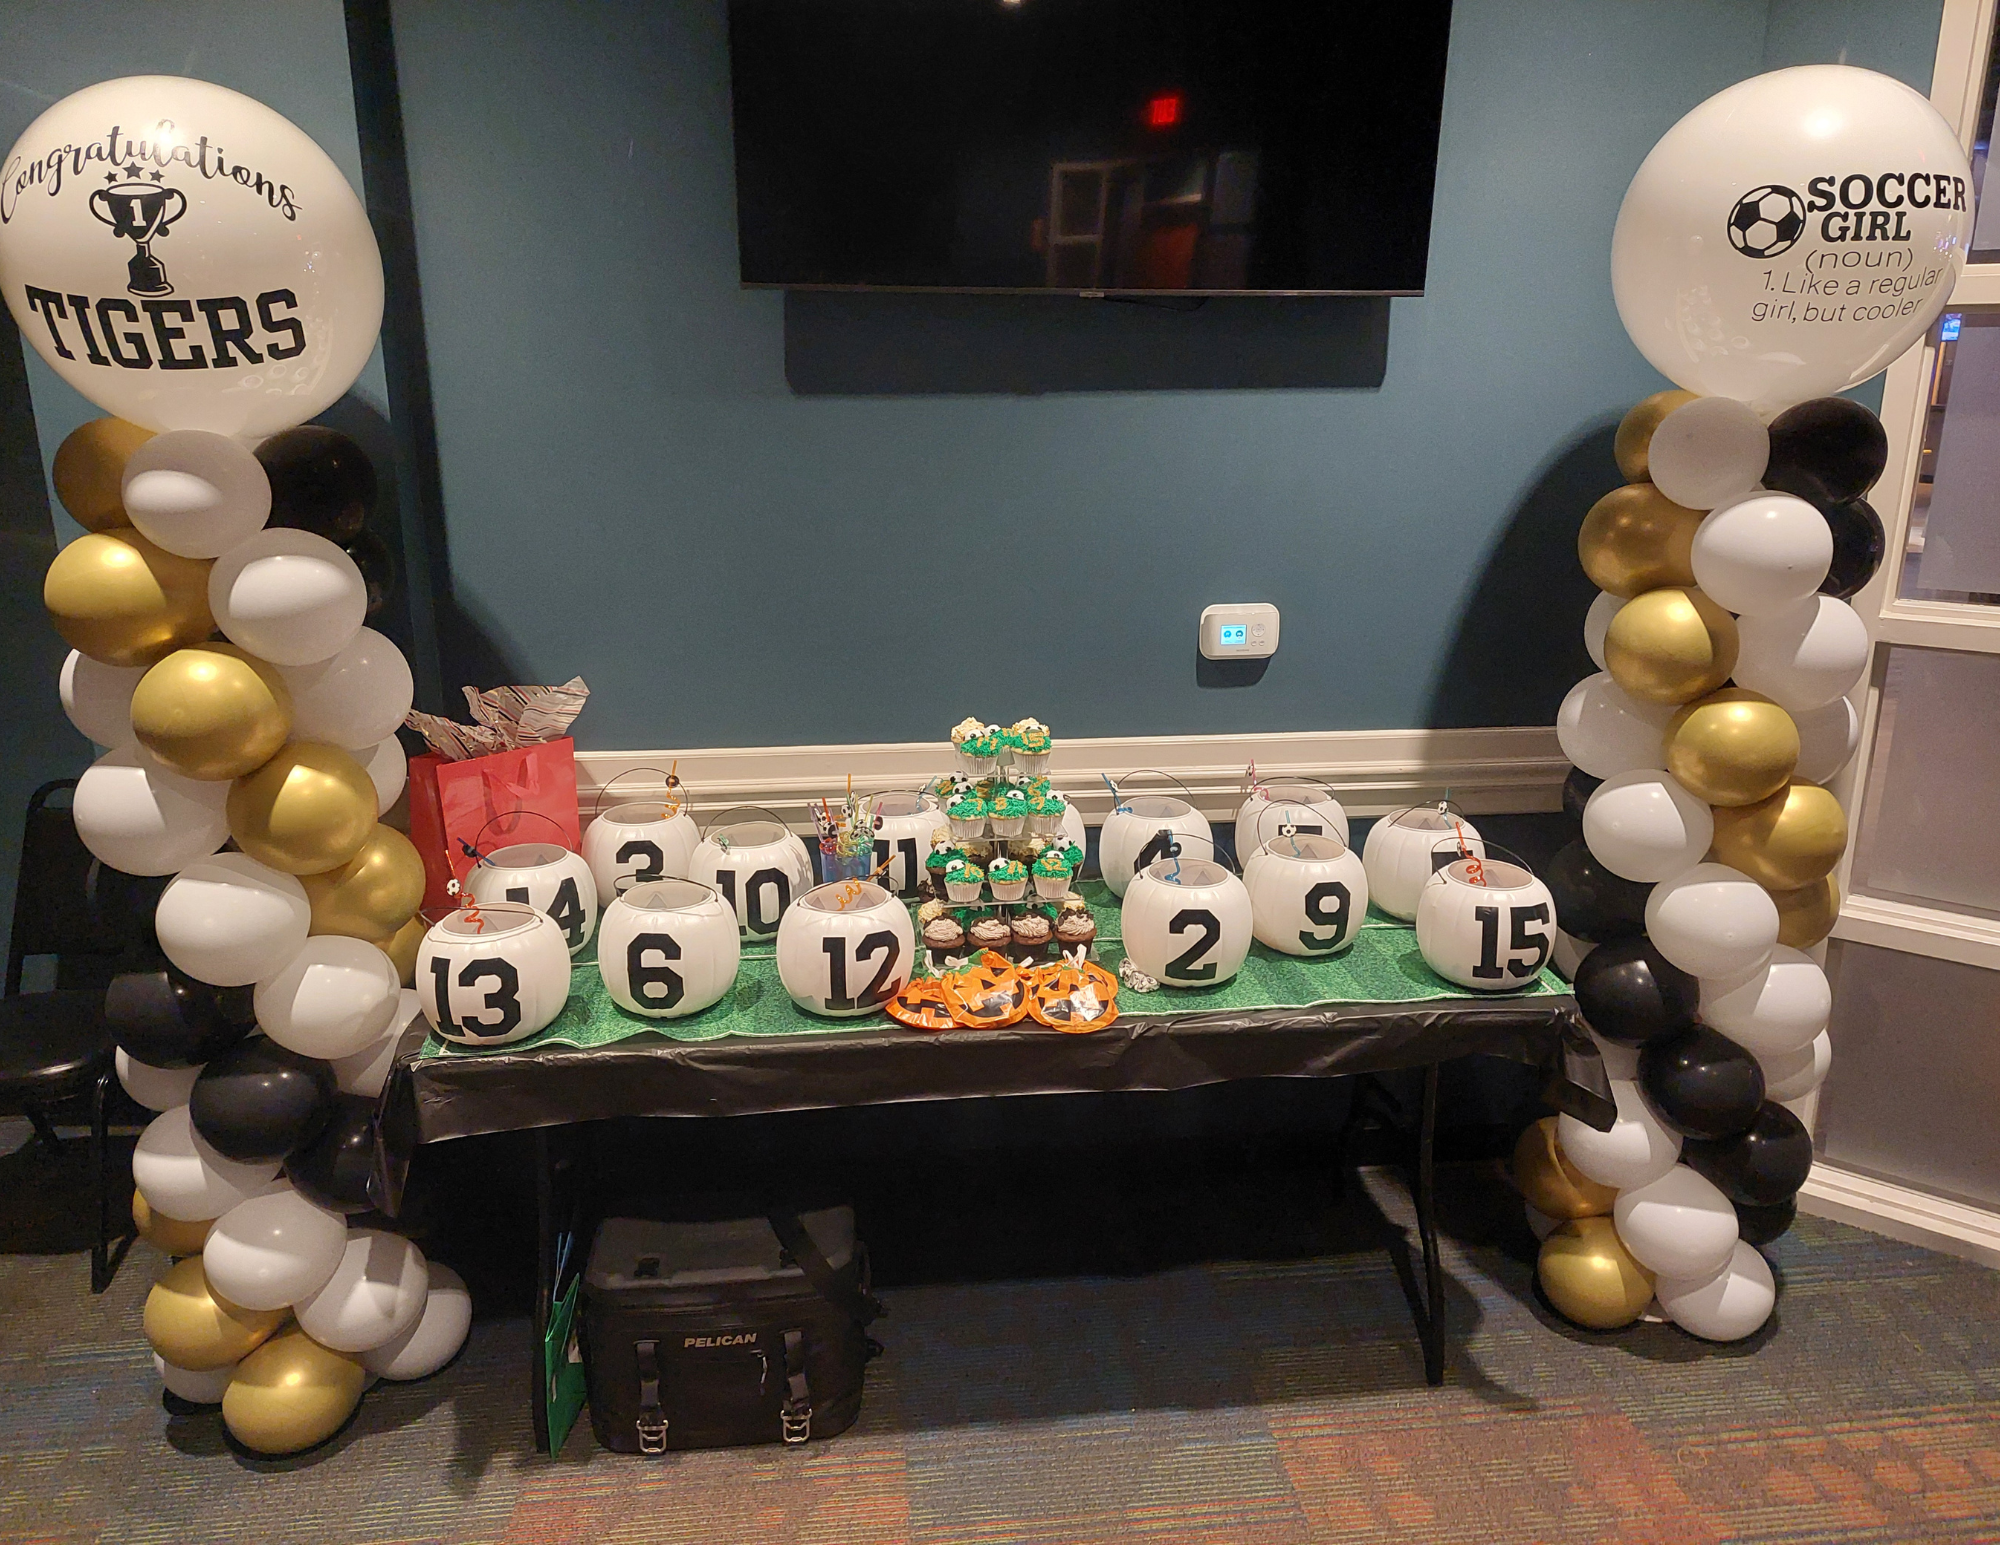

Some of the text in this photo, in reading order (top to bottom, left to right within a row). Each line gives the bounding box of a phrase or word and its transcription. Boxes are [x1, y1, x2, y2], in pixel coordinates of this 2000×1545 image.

[0, 118, 303, 224] Congratulations
[1807, 172, 1967, 213] SOCCER
[1805, 248, 1914, 273] (noun)
[1821, 210, 1912, 242] GIRL
[1751, 297, 1923, 324] girl, but cooler
[1762, 266, 1944, 300] 1. Like a regular
[25, 284, 307, 370] TIGERS
[716, 867, 791, 936] 10
[872, 837, 919, 899] 11
[1164, 909, 1221, 981] 2
[1299, 881, 1351, 950] 9
[1472, 902, 1551, 980] 15
[429, 956, 521, 1038] 13
[626, 932, 685, 1009] 6
[822, 929, 901, 1011] 12
[684, 1332, 758, 1348] PELICAN
